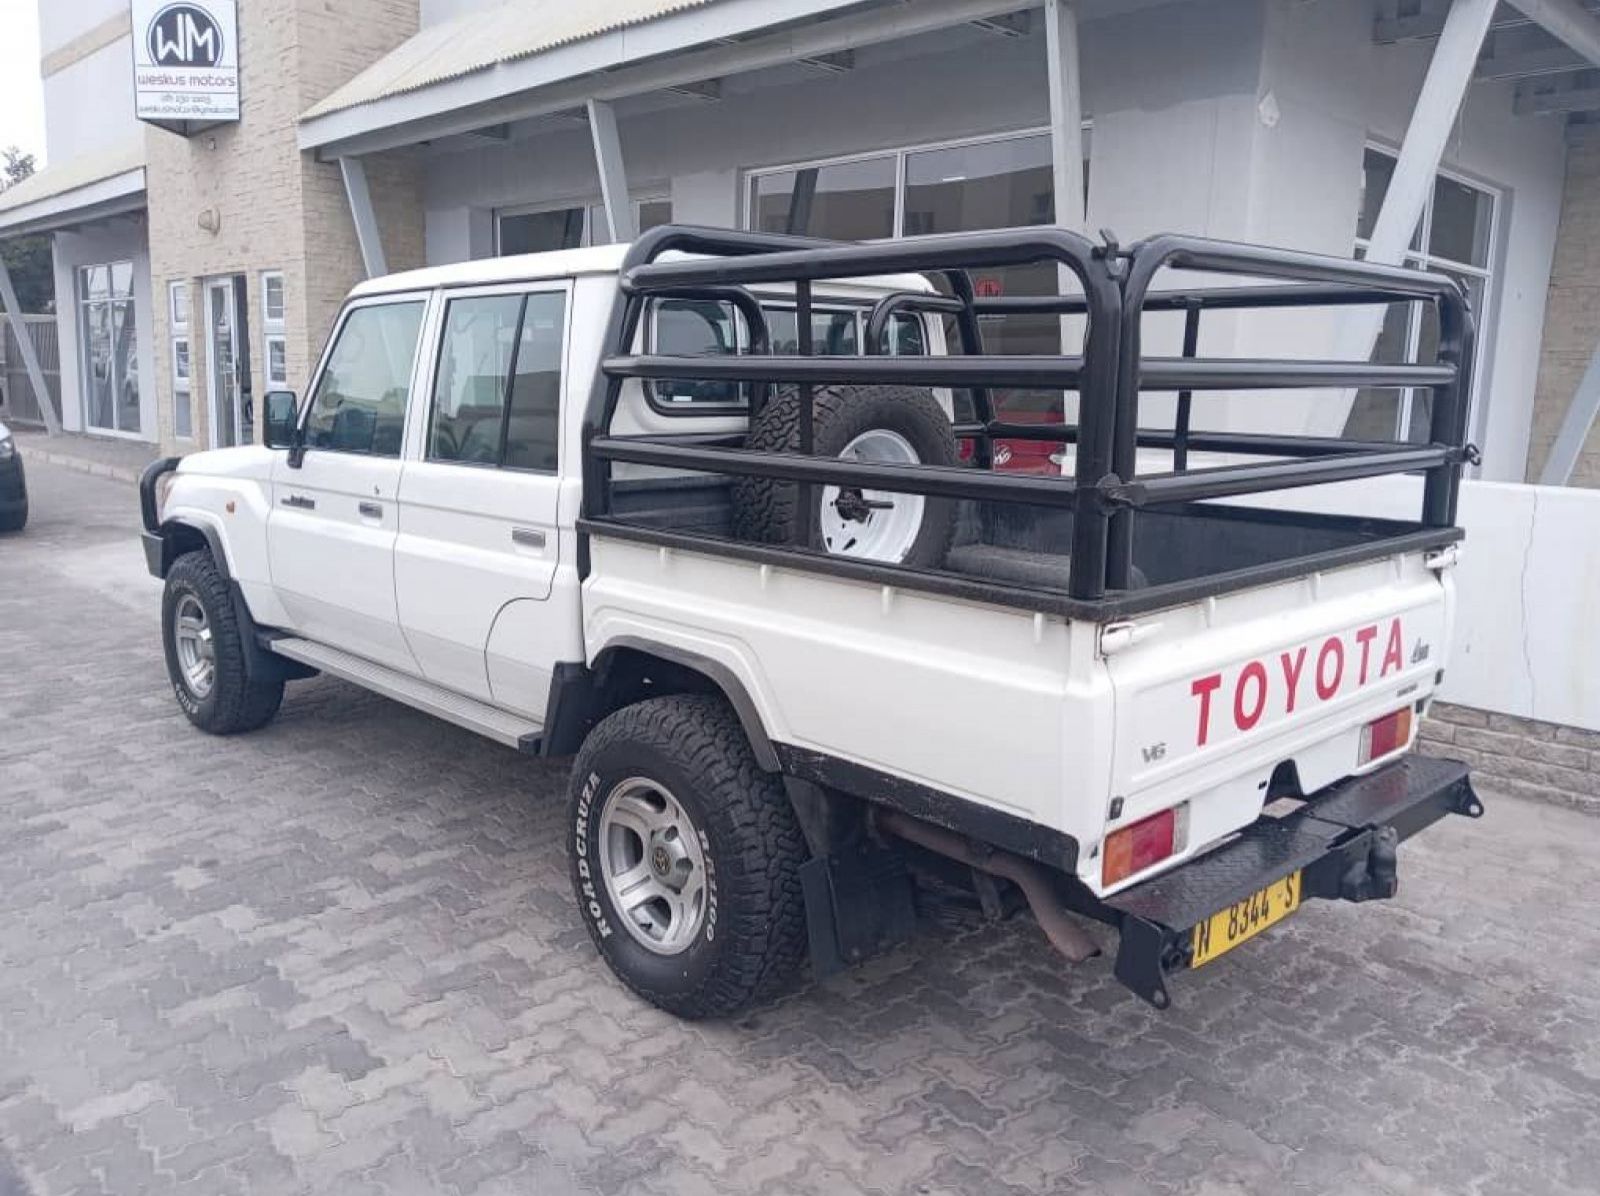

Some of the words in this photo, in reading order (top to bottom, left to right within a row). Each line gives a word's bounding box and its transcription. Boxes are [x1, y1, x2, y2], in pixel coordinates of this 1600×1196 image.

[156, 12, 215, 61] WM
[189, 74, 236, 87] motors
[1190, 617, 1403, 747] TOYOTA
[1141, 742, 1167, 763] V6
[577, 772, 612, 938] ROADCRUZA
[1197, 916, 1211, 958] N
[1228, 887, 1269, 940] 8344
[1285, 872, 1294, 909] S
